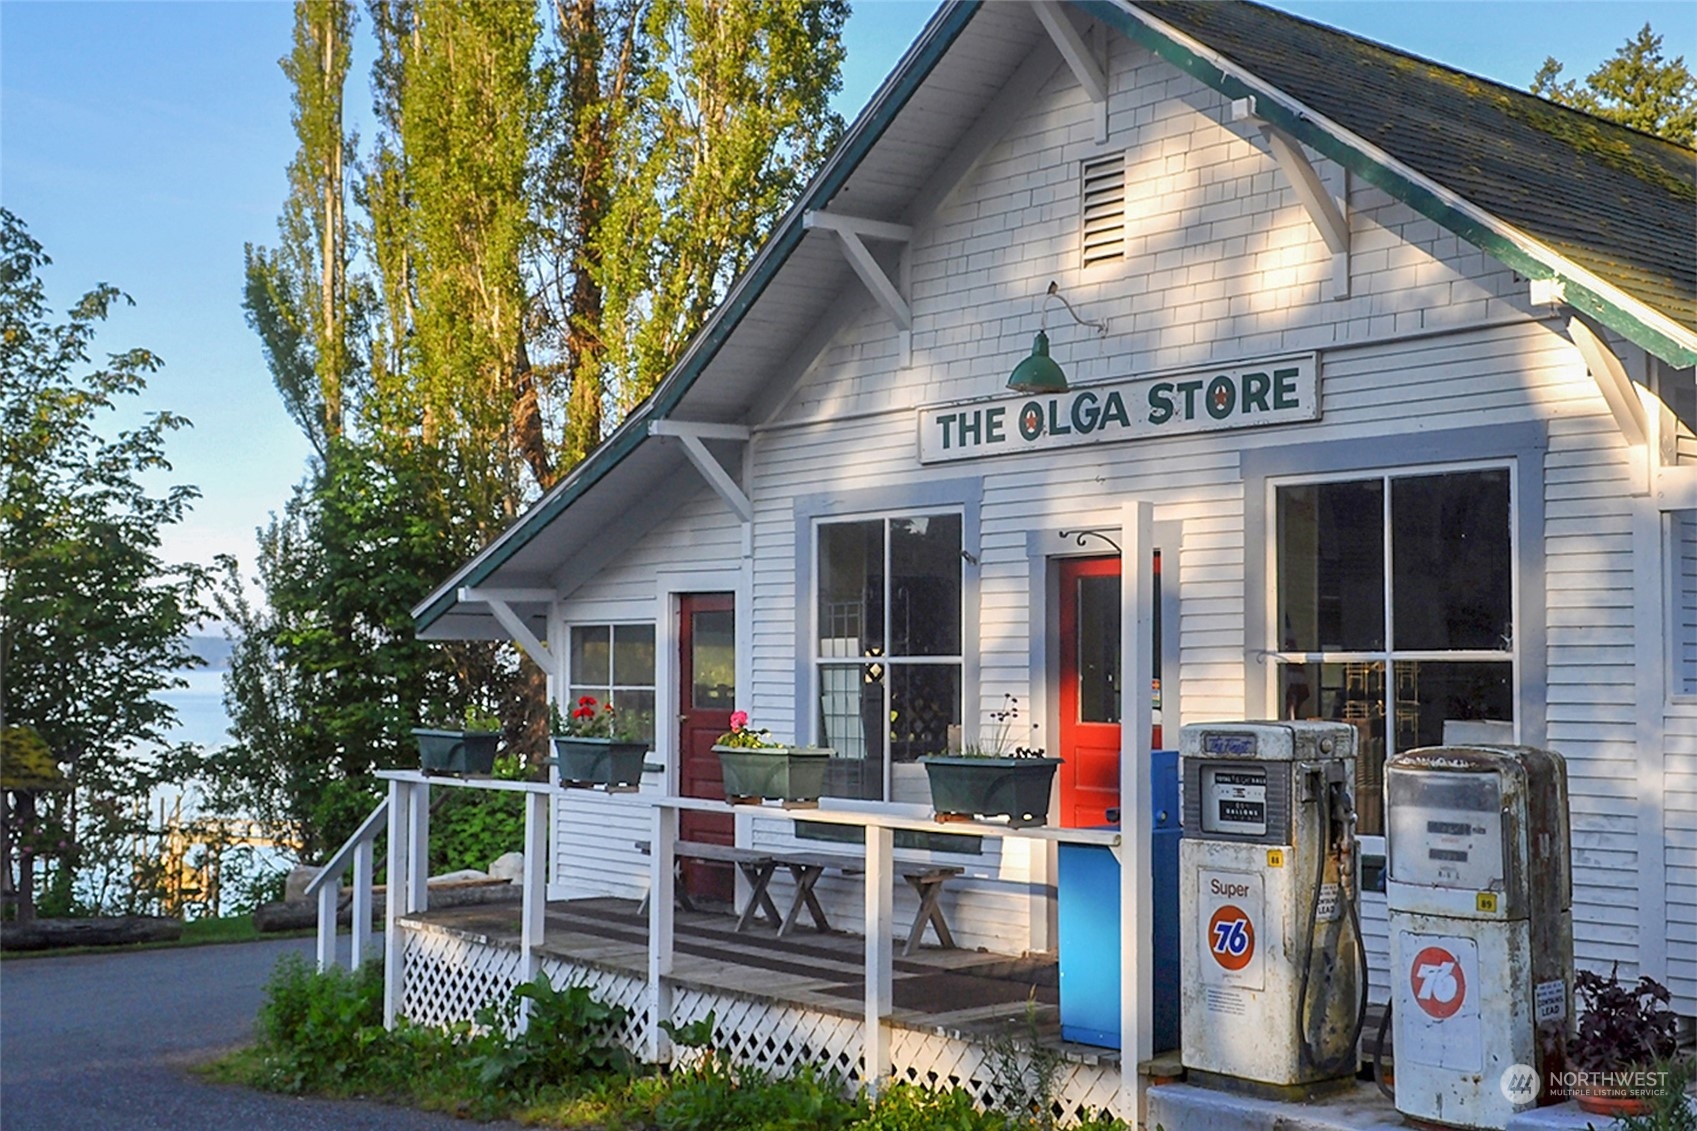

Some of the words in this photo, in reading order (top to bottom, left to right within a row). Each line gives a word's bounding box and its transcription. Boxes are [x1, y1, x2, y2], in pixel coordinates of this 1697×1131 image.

[936, 406, 1006, 449] THE
[1018, 391, 1131, 442] OLGA
[1147, 367, 1300, 425] STORE
[1225, 807, 1258, 817] GALLONS
[1211, 878, 1250, 899] Super
[1213, 918, 1248, 957] 76
[1416, 961, 1459, 1004] 76
[1541, 1004, 1560, 1017] LEAD
